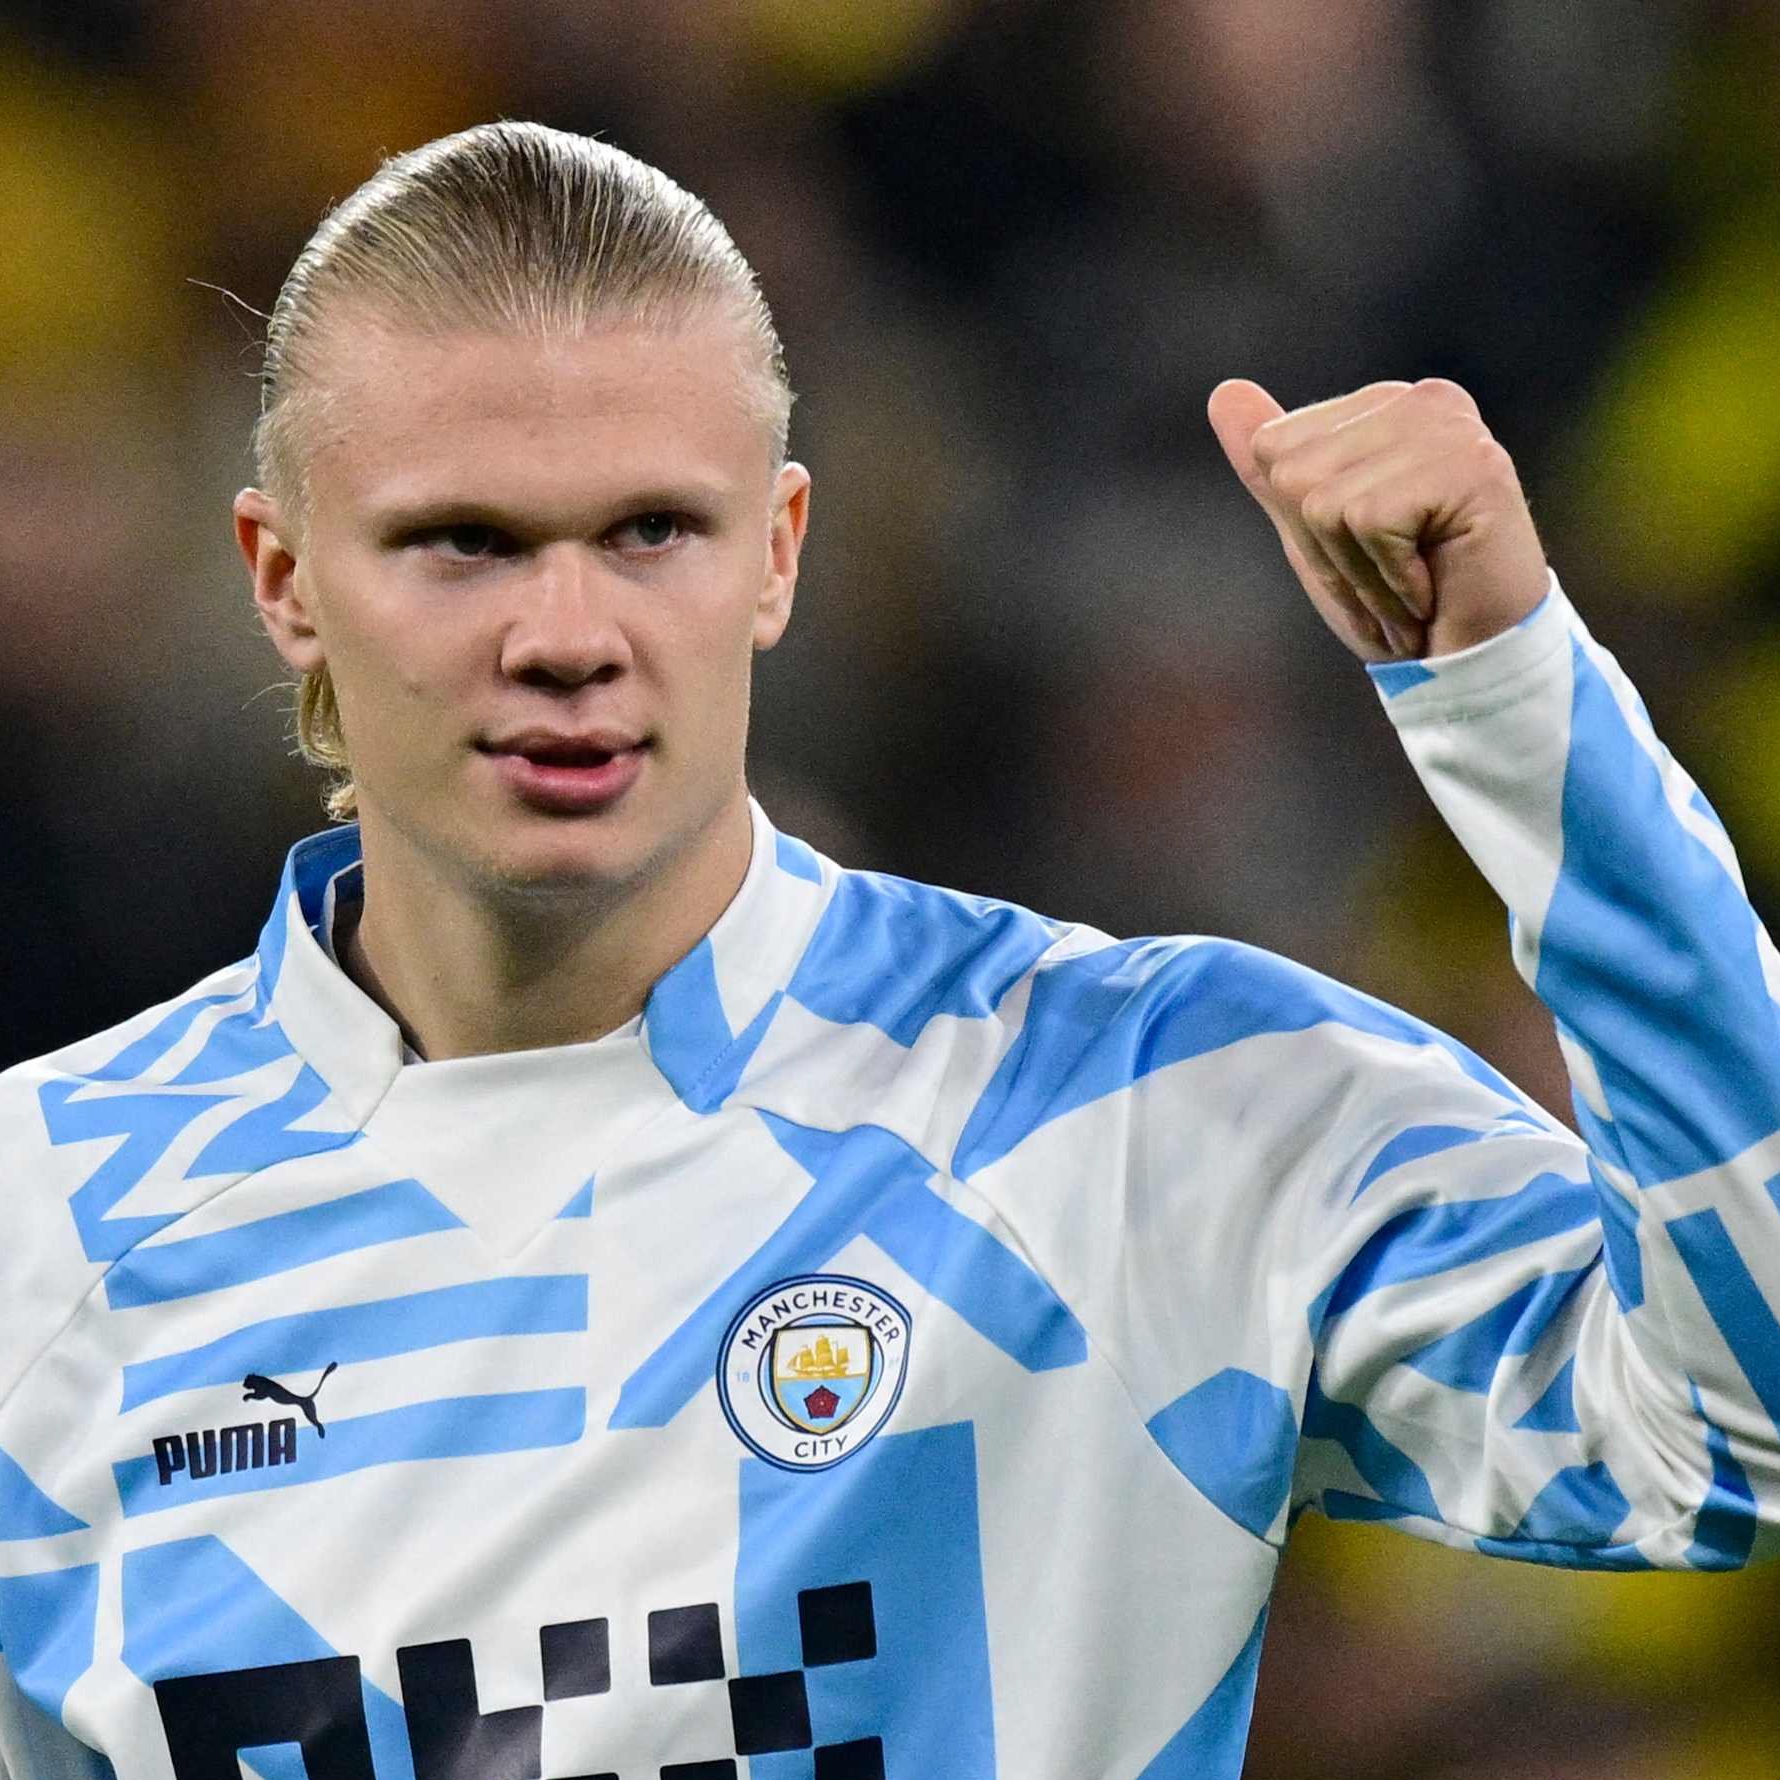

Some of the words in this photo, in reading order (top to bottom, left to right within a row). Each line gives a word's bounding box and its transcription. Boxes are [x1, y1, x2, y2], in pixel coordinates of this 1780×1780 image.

[741, 1290, 900, 1350] MANCHESTER
[152, 1416, 297, 1486] PUMA
[794, 1435, 848, 1458] CITY
